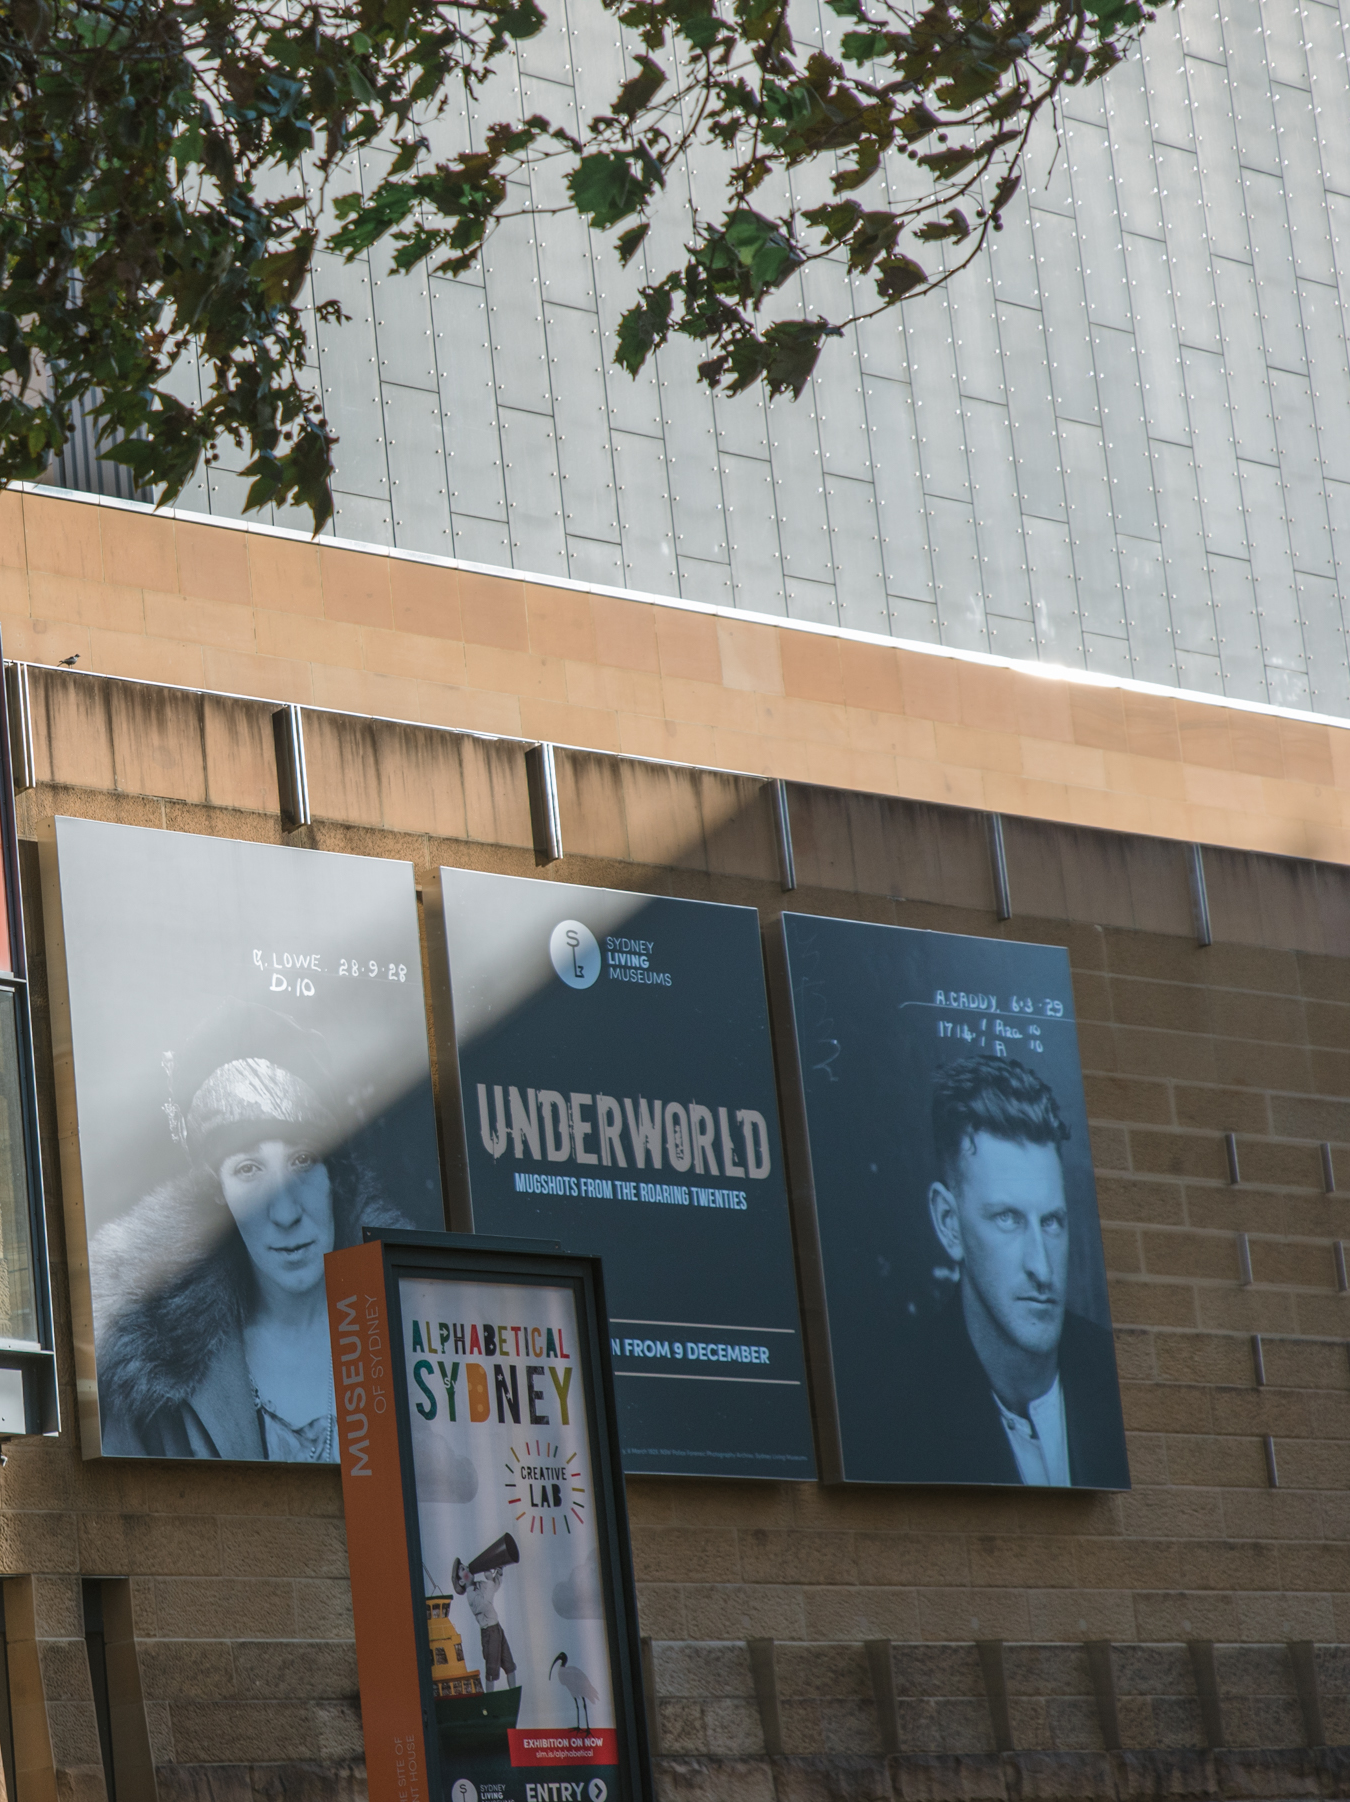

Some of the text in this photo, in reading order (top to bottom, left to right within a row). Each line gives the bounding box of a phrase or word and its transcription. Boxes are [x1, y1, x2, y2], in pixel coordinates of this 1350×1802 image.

[606, 936, 655, 955] SYDNEY
[607, 952, 650, 969] LIVING
[609, 967, 673, 987] MUSEUMS
[477, 1083, 772, 1180] UNDERWORLD
[513, 1171, 748, 1211] MUGSHOTS FROM THE ROARING TWENTIES
[411, 1319, 571, 1360] ALPHABETICAL
[624, 1338, 671, 1359] FROM
[674, 1342, 684, 1360] 9
[685, 1342, 770, 1364] DECEMBER
[364, 1294, 387, 1414] OF SYDNEY
[336, 1294, 373, 1477] MUSEUM
[412, 1358, 573, 1426] SYDNEY
[520, 1466, 568, 1481] CREATIVE
[529, 1483, 563, 1509] LAB
[523, 1737, 604, 1749] EXHIBITION ON NOW
[535, 1749, 594, 1759] slm.is/alphabetical
[405, 1734, 419, 1782] HOUSE
[479, 1783, 507, 1792] SYDNEY
[481, 1791, 504, 1800] LIVING
[525, 1781, 585, 1802] ENTRY
